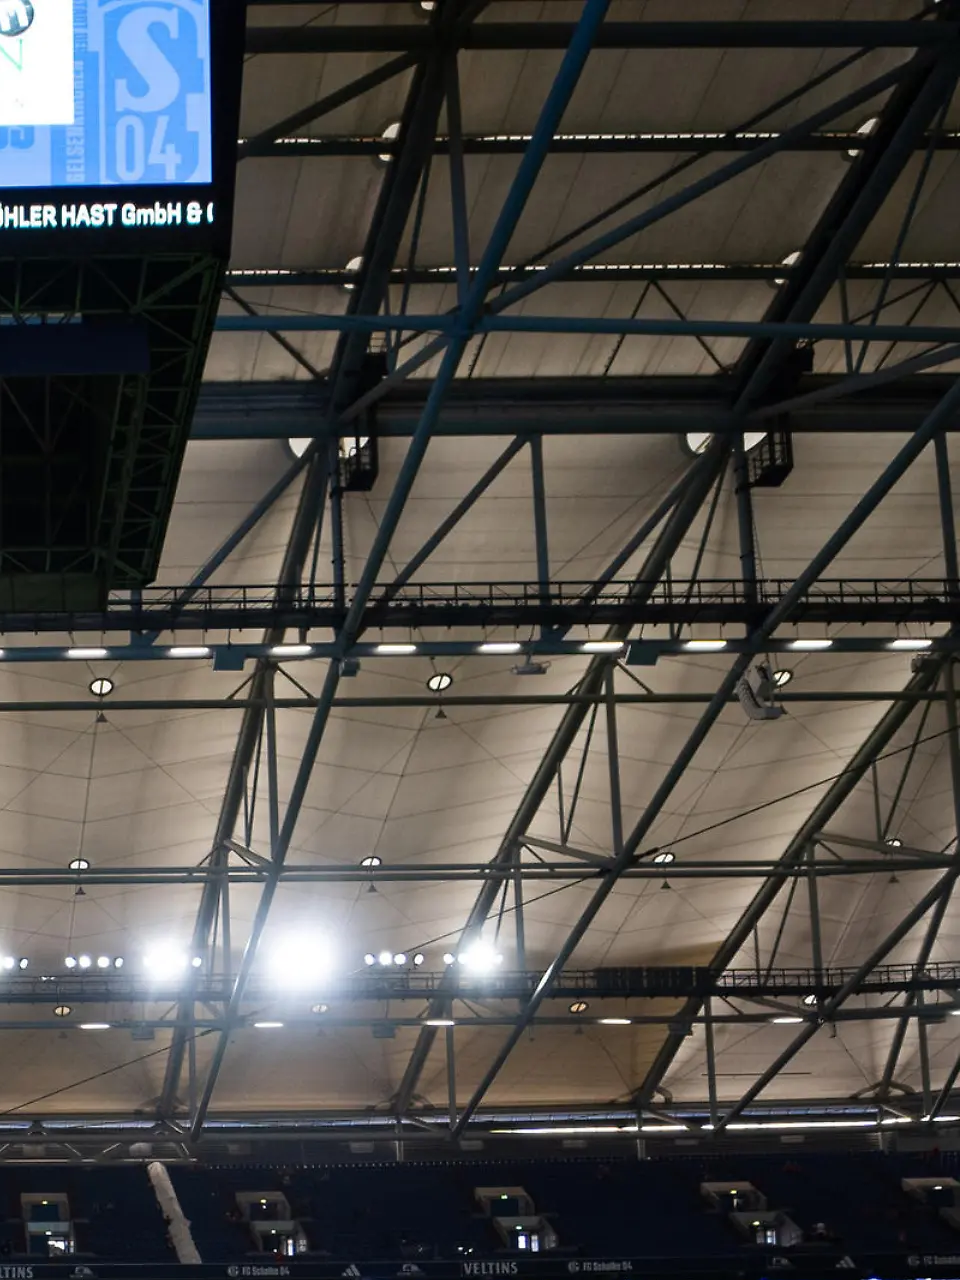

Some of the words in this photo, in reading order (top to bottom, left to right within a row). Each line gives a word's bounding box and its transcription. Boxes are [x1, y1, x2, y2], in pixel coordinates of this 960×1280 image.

[62, 203, 117, 228] HAST
[121, 201, 181, 226] GmbH
[186, 201, 202, 225] &
[464, 1262, 518, 1276] VELTINS
